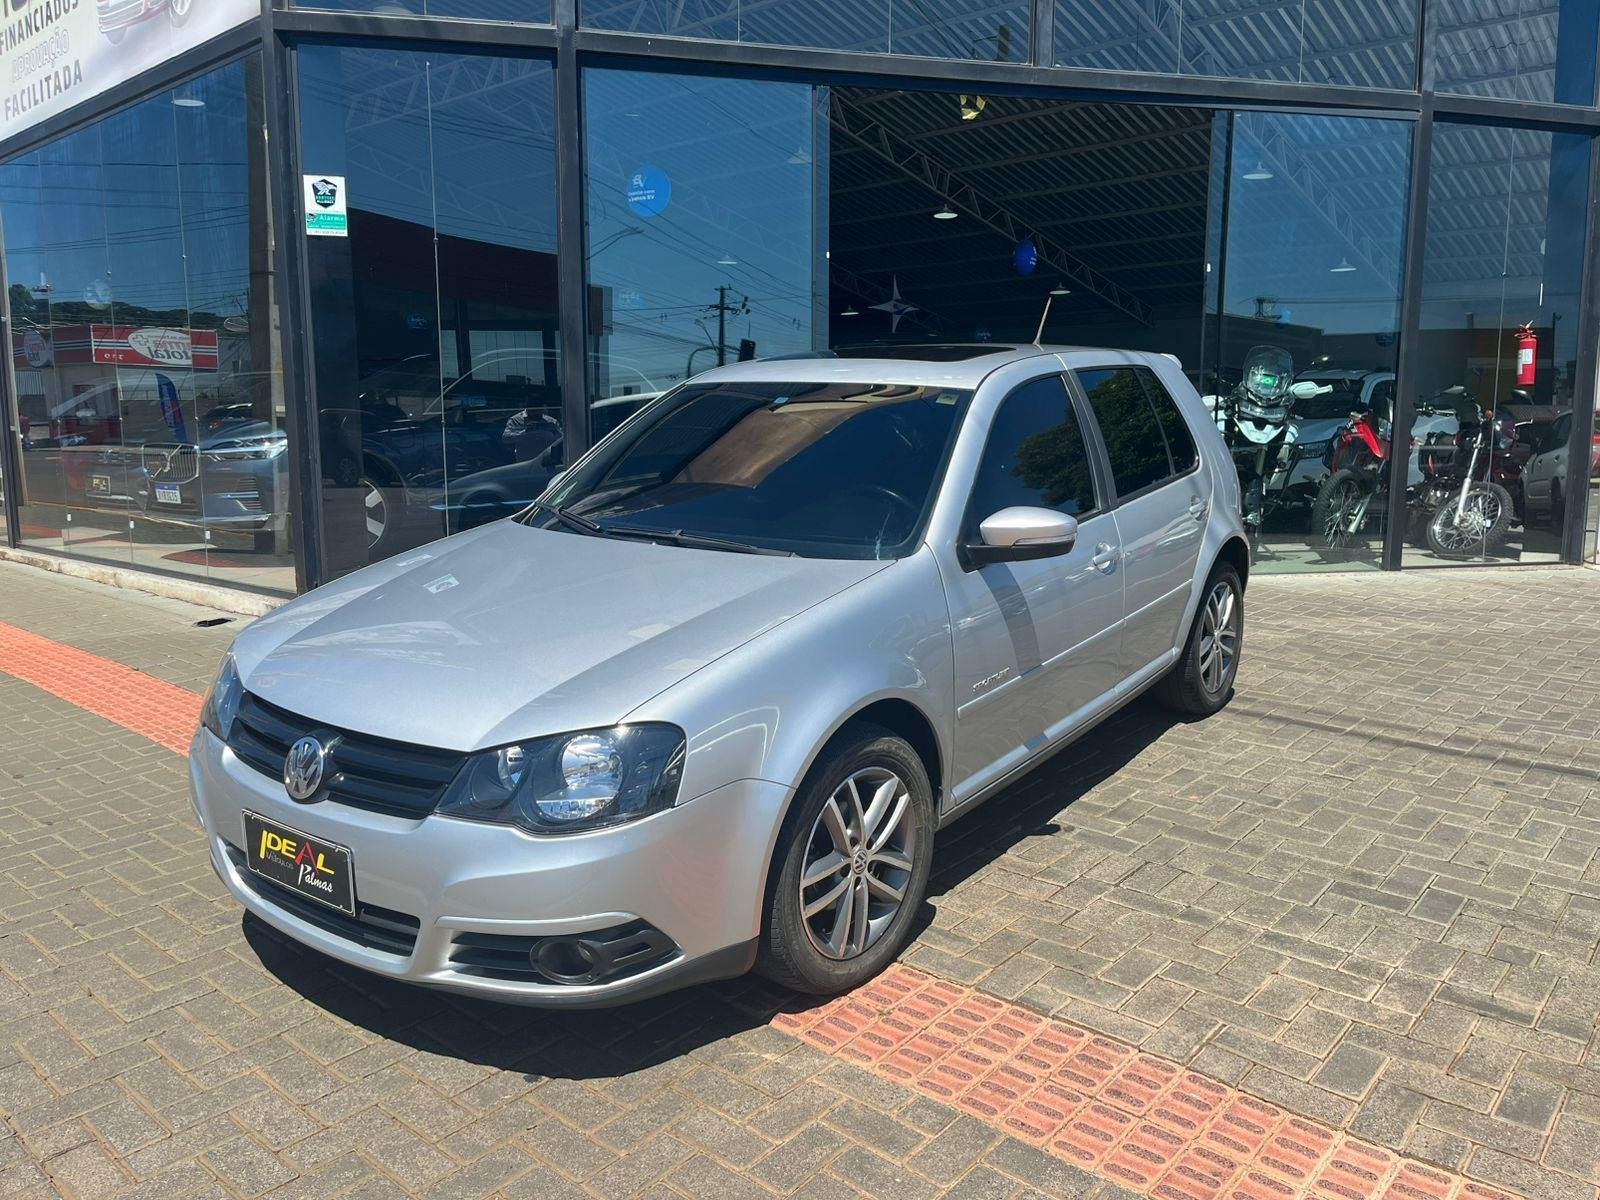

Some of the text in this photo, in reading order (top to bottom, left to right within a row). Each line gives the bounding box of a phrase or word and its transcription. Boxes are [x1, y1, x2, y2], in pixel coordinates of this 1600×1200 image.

[4, 59, 82, 121] FACILITADA
[259, 829, 335, 875] IDEAL
[297, 863, 334, 893] Palmas
